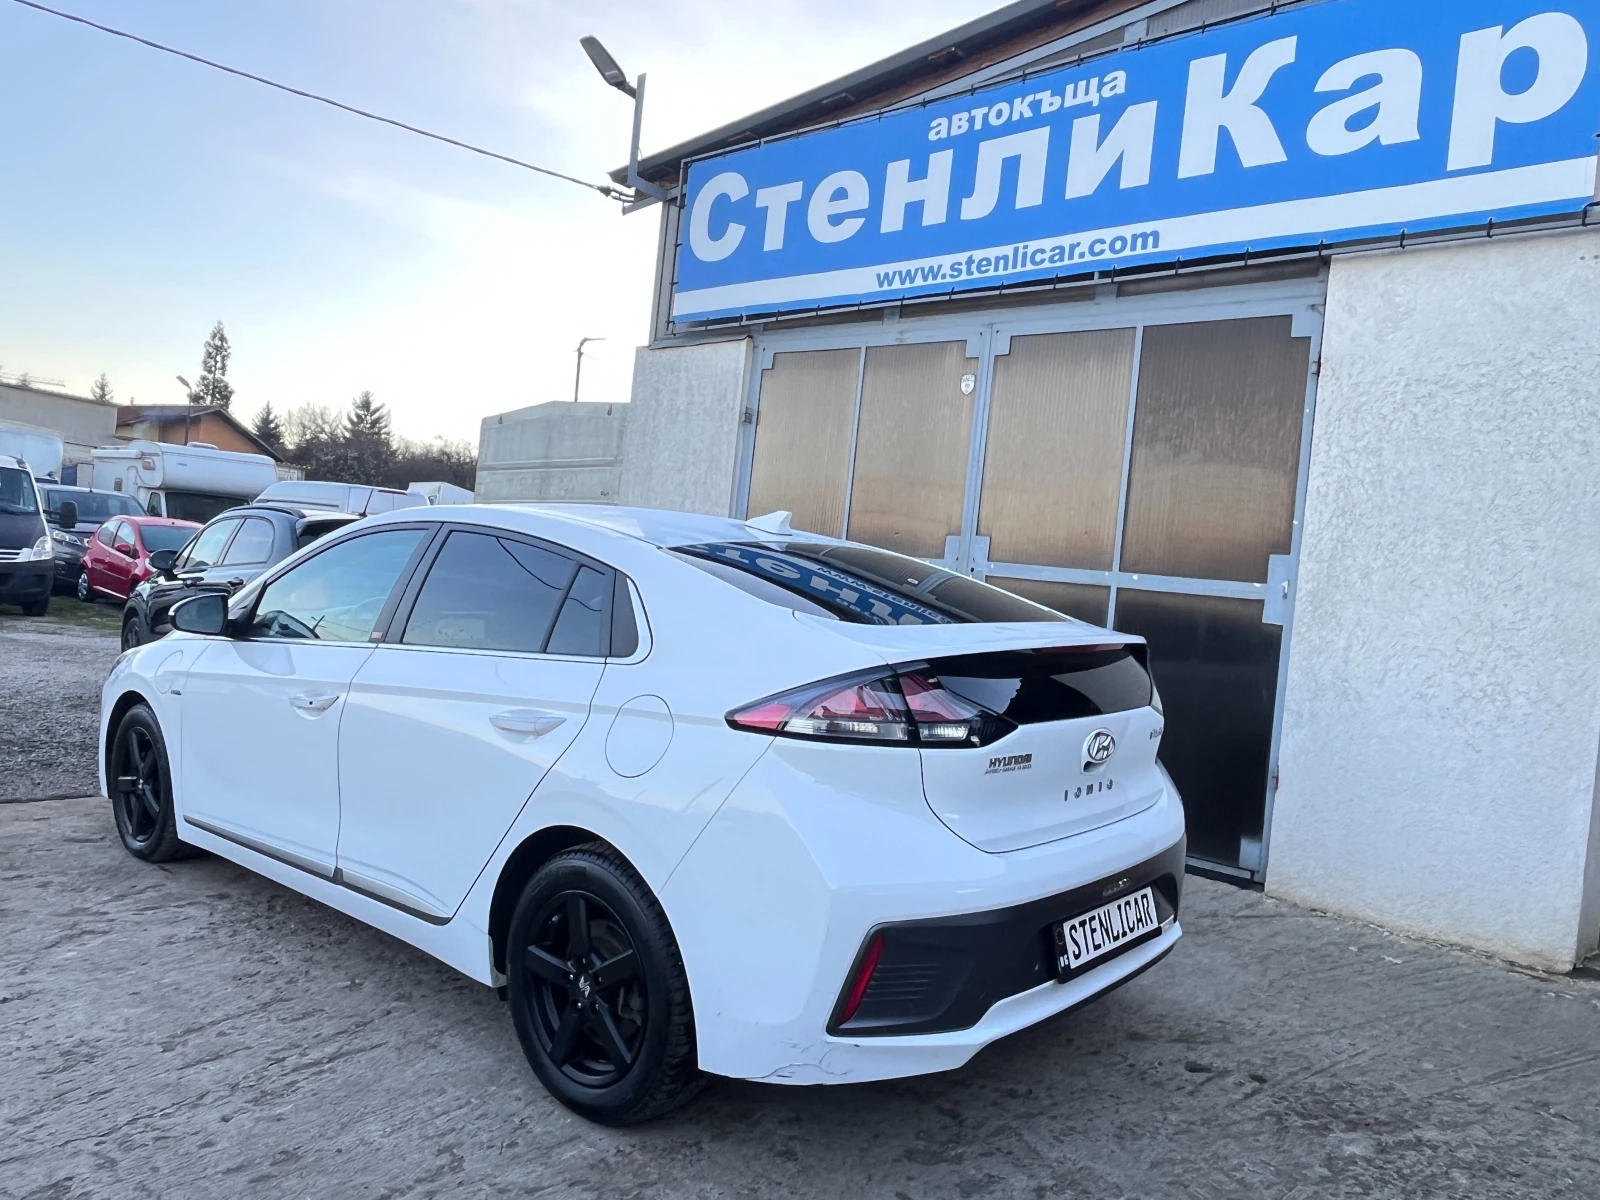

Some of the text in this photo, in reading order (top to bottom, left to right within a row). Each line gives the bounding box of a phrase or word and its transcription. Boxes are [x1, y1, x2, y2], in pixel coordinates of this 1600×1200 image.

[689, 11, 1588, 262] СтенлиКар
[928, 70, 1127, 142] автокъща
[876, 229, 1161, 289] www.stenlicar.com
[988, 753, 1033, 769] HYUNDAI
[1068, 892, 1154, 961] STENLICAR
